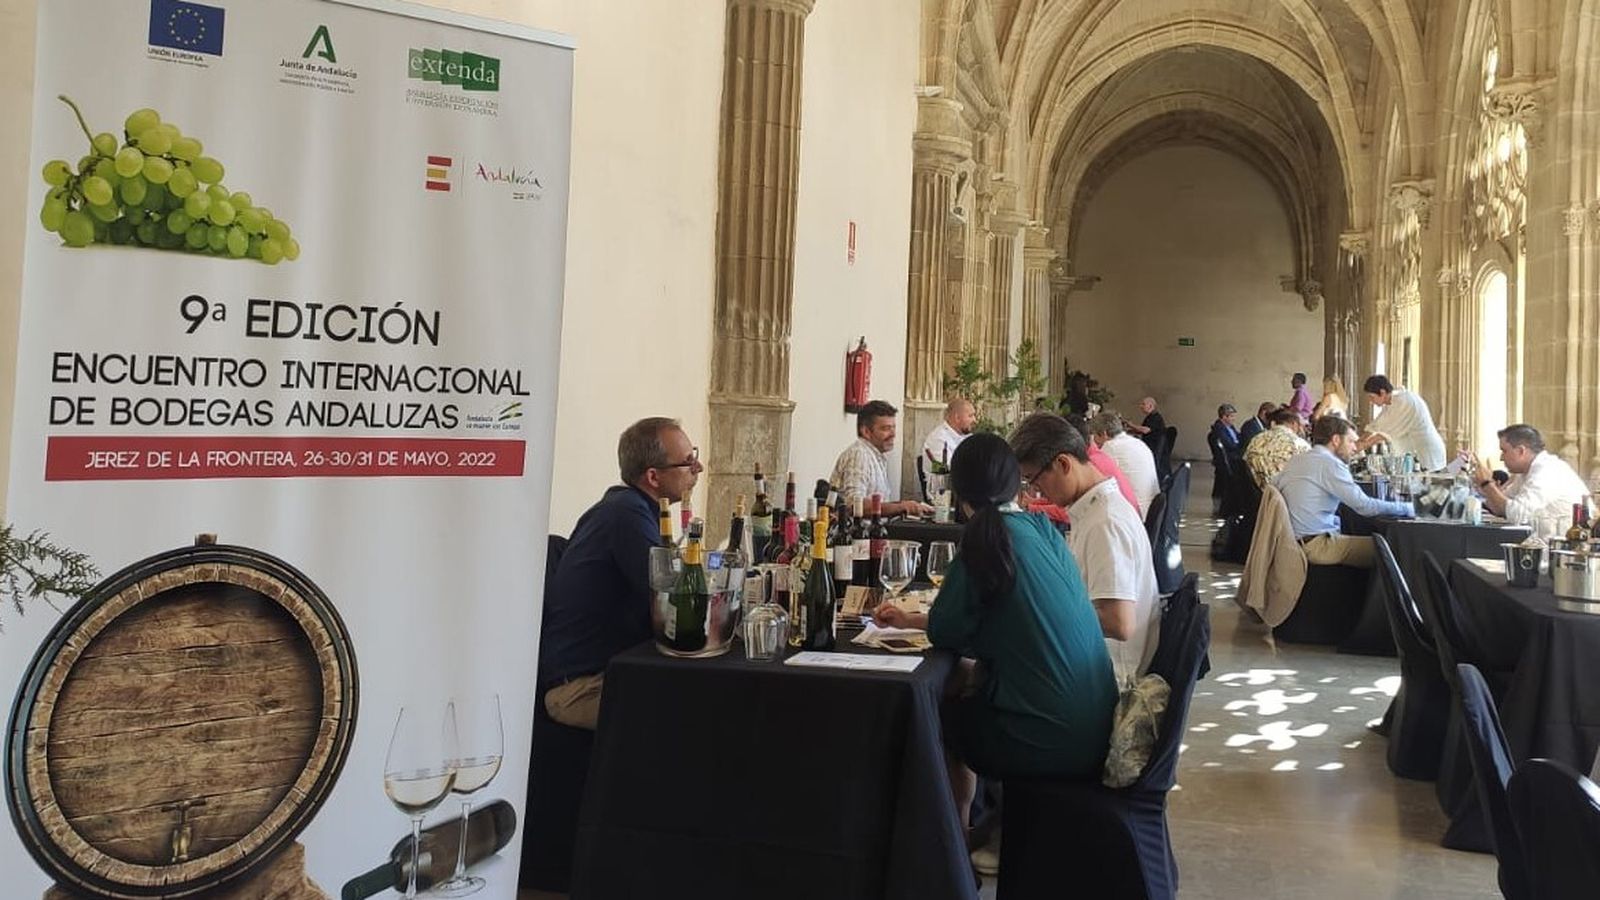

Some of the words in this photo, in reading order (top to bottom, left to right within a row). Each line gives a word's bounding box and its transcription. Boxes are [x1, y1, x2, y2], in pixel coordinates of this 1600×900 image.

[279, 59, 304, 70] Junta
[306, 63, 316, 72] de
[410, 55, 496, 84] extenda
[246, 299, 441, 346] EDICIÓN
[52, 352, 267, 388] ENCUENTRO
[281, 360, 530, 396] INTERNACIONAL
[49, 396, 96, 425] DE
[110, 397, 274, 427] BODEGAS
[286, 400, 459, 429] ANDALUZAS
[85, 451, 139, 468] JEREZ
[147, 451, 172, 468] DE
[178, 451, 200, 468] LA
[206, 451, 298, 468] FRONTERA,
[303, 451, 373, 467] 26-30/31
[378, 451, 399, 467] DE
[404, 451, 451, 468] MAYO,
[457, 452, 496, 467] 2022
